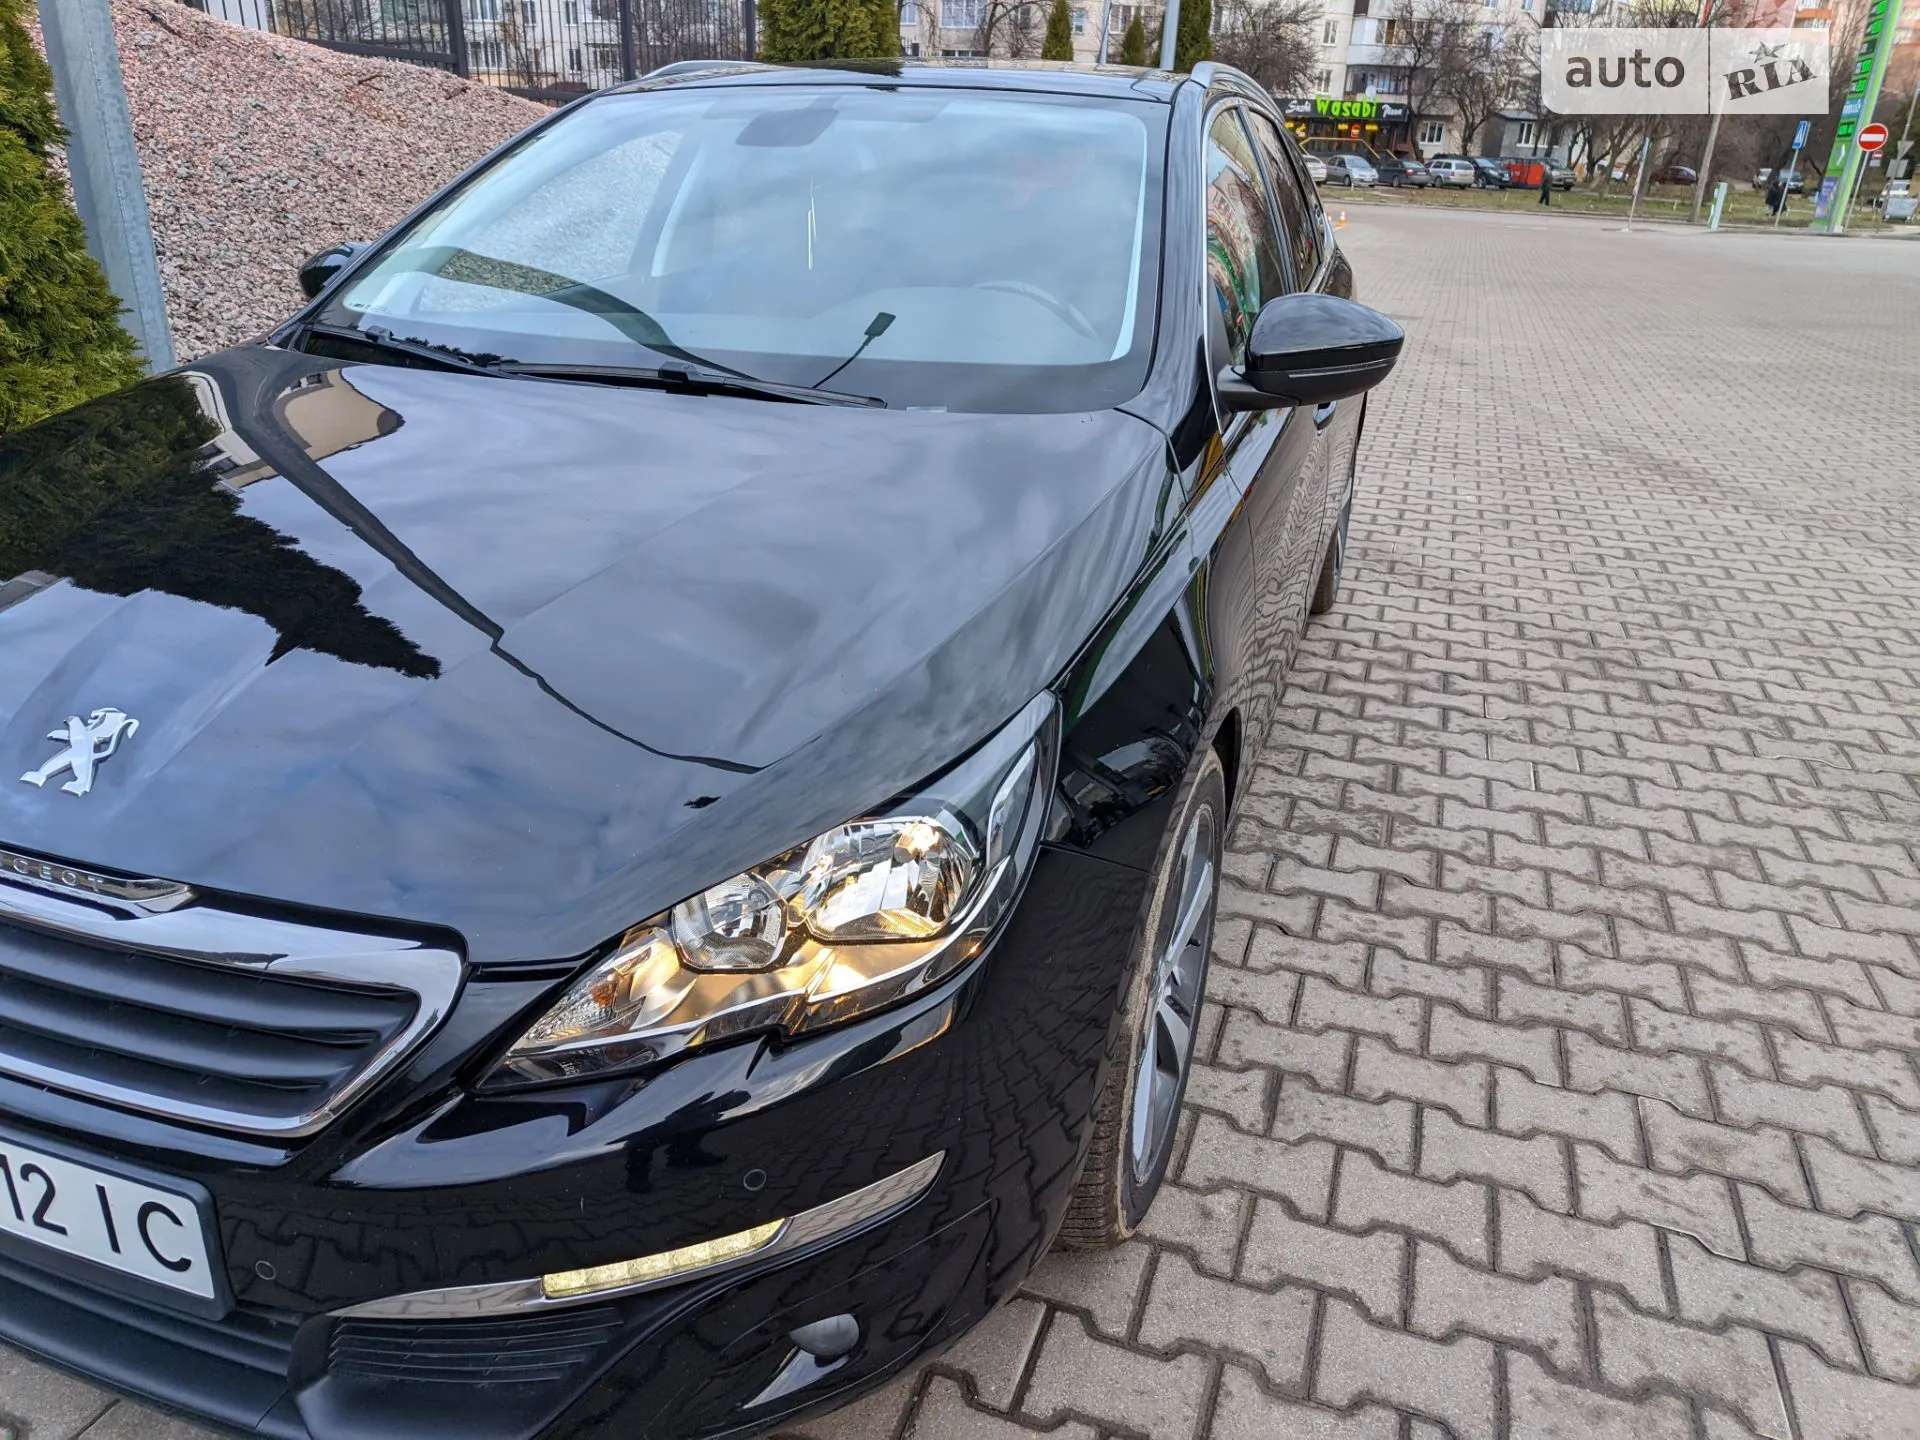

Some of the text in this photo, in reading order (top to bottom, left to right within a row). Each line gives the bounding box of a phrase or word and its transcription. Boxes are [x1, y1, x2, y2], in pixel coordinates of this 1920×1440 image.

[1285, 100, 1312, 114] Sushi
[1315, 95, 1378, 118] Wasabi
[95, 1183, 192, 1272] IC
